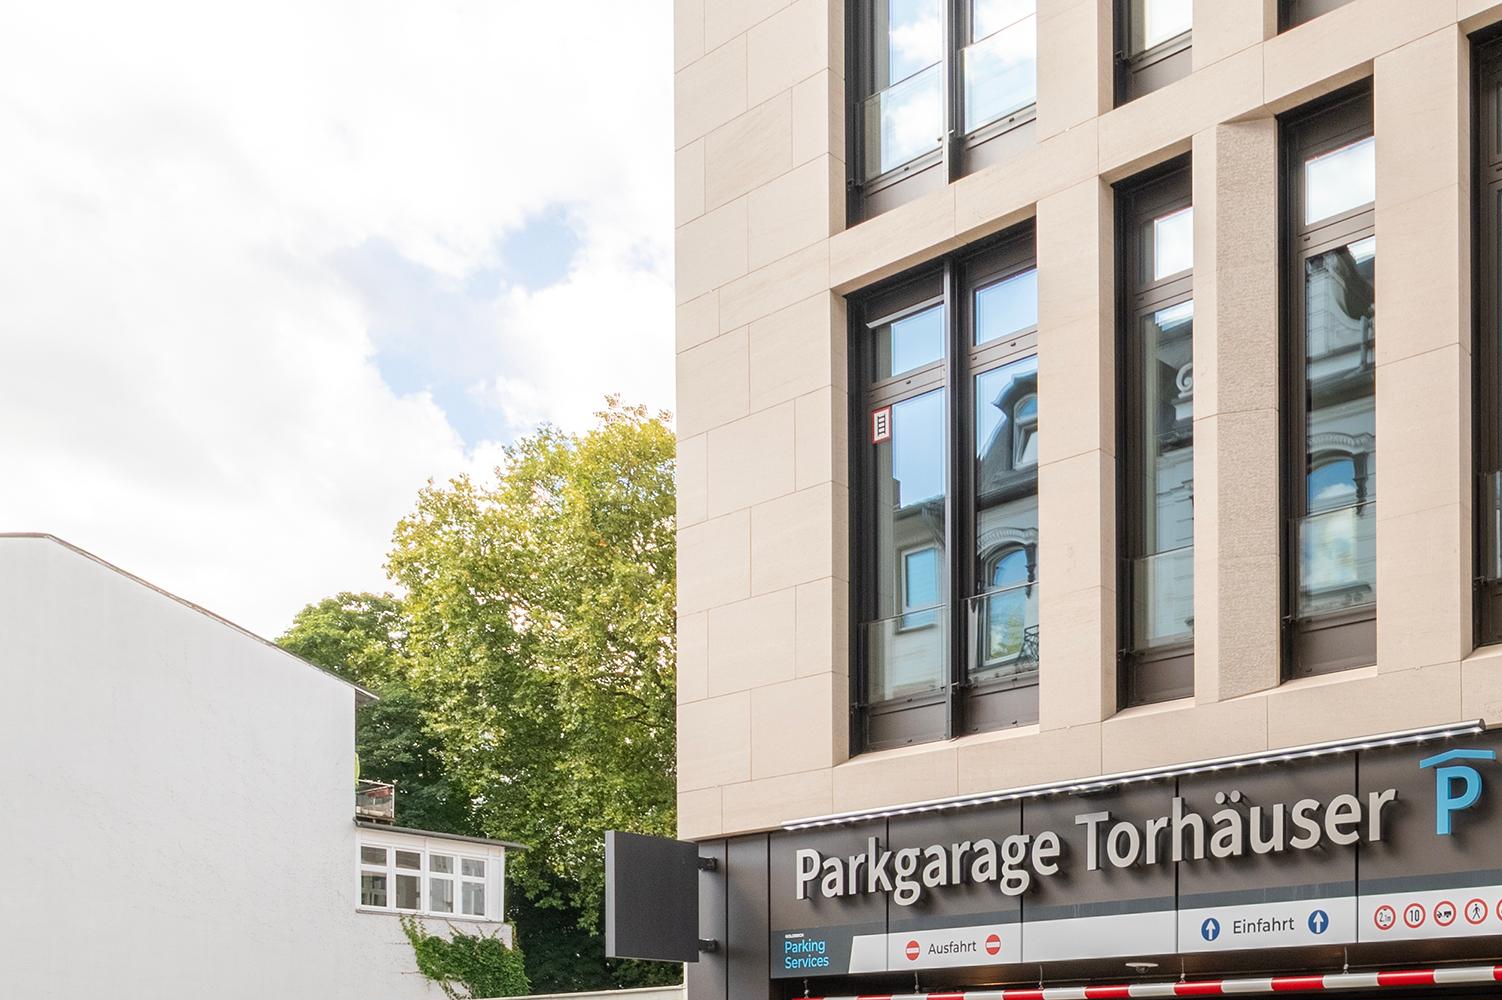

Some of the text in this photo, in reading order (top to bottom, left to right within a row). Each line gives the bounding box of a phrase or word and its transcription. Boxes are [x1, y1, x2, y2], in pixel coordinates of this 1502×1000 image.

[1436, 766, 1483, 835] P
[796, 788, 1398, 906] Parkgarage Torhäuser
[1409, 909, 1420, 922] 10
[1233, 917, 1295, 934] Einfahrt
[784, 938, 826, 954] Parking
[928, 940, 977, 955] Ausfahrt
[784, 954, 830, 969] Services
